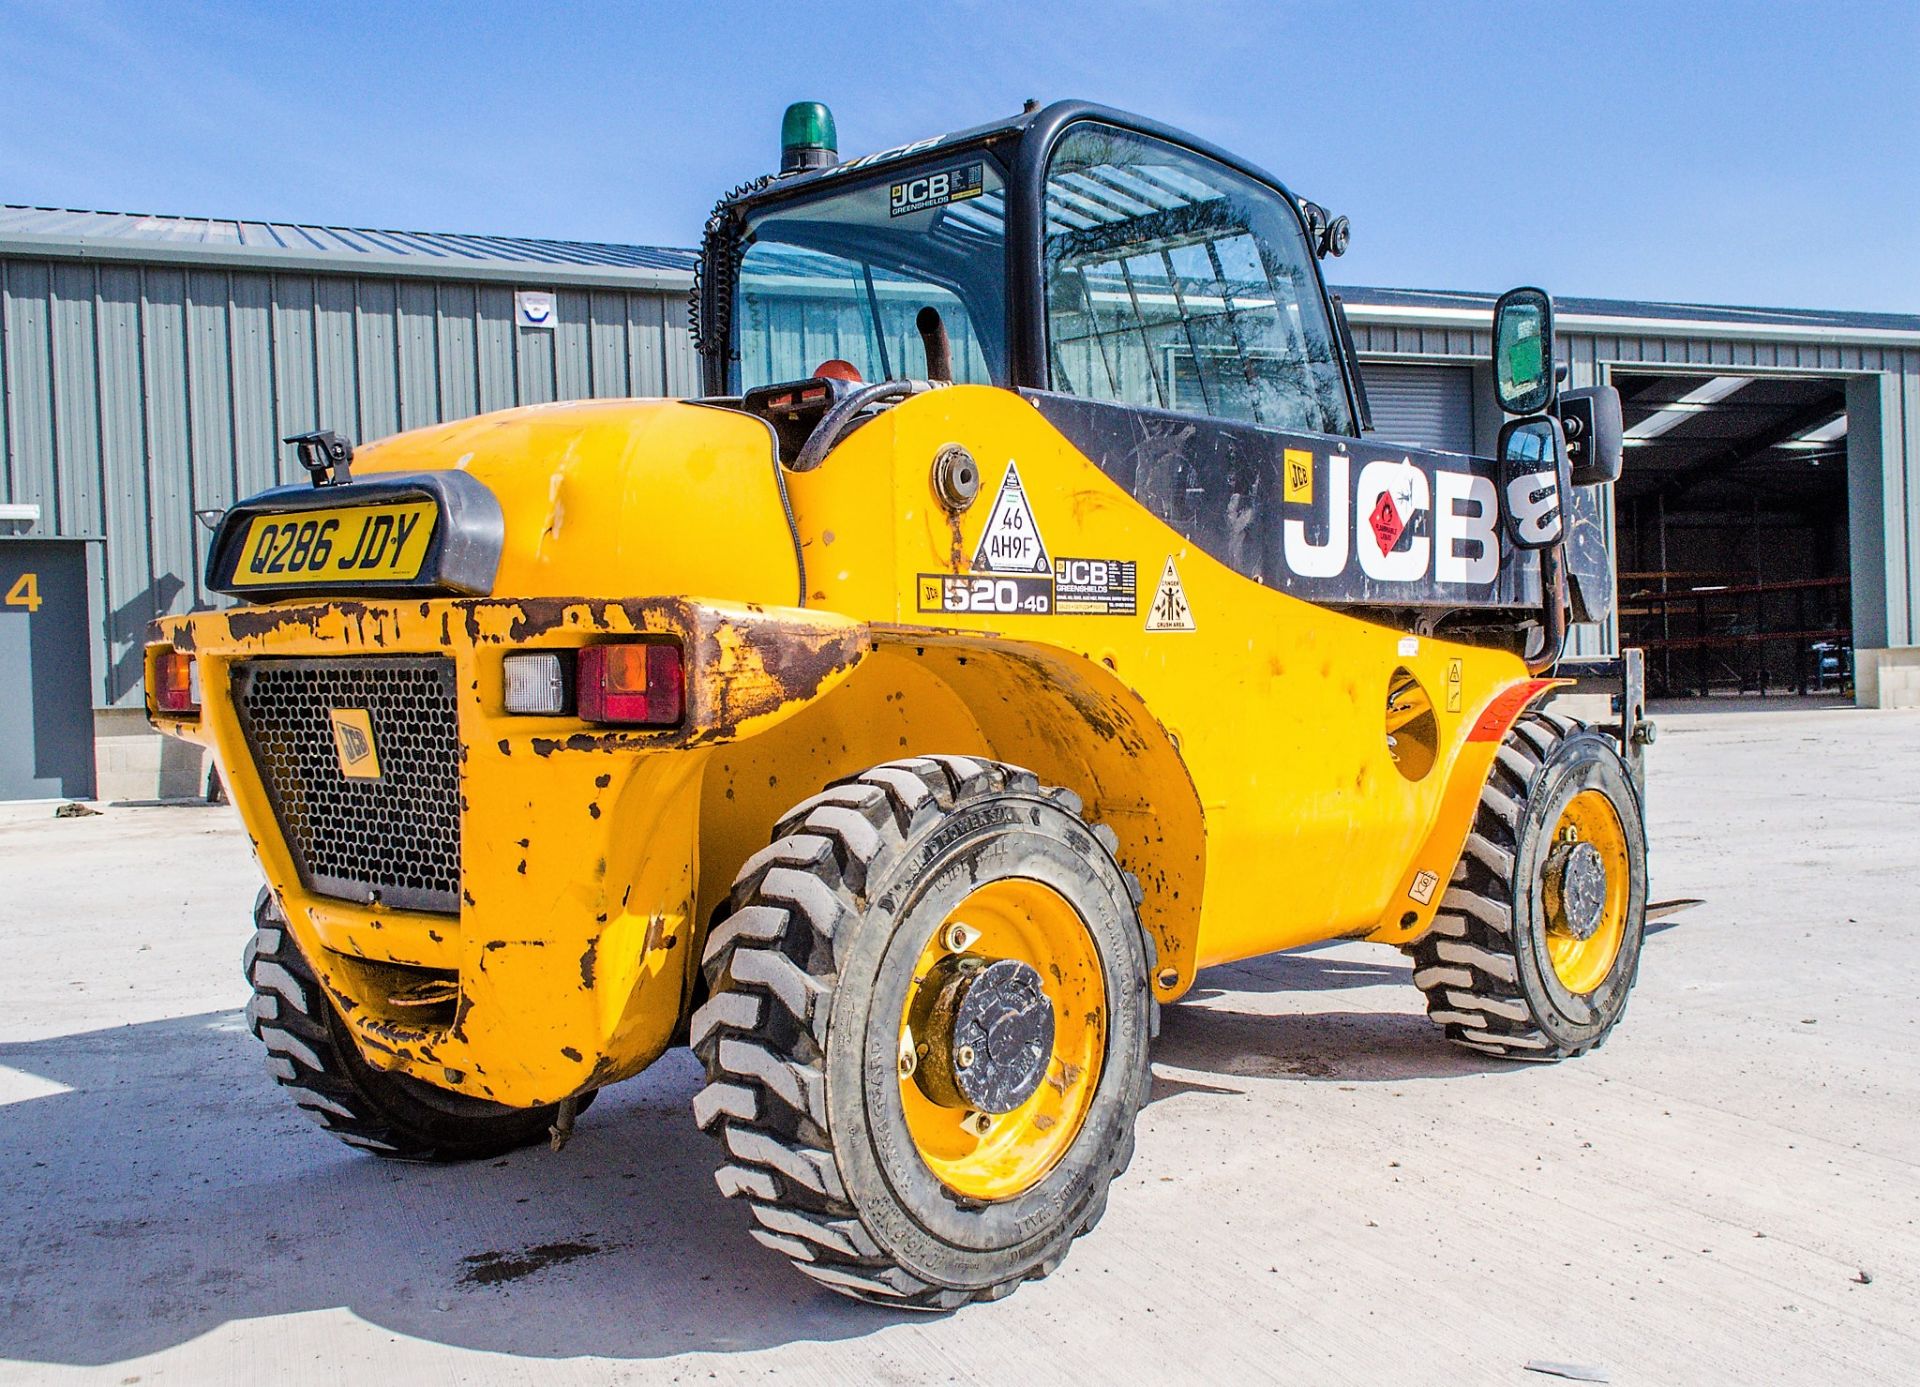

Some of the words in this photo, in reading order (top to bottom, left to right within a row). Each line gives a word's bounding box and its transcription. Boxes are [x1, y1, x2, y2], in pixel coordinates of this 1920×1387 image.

[892, 174, 949, 208] JCB
[892, 195, 949, 215] GREENSHIELDS
[1292, 463, 1308, 486] JCB
[1003, 507, 1023, 530] 46
[1284, 455, 1499, 584] JCB
[250, 519, 340, 574] Q286
[338, 513, 420, 570] JDY
[991, 535, 1033, 558] AH9F
[1056, 561, 1108, 585] JCB
[5, 573, 43, 612] 4
[1057, 585, 1108, 593] GREENSHIELDS
